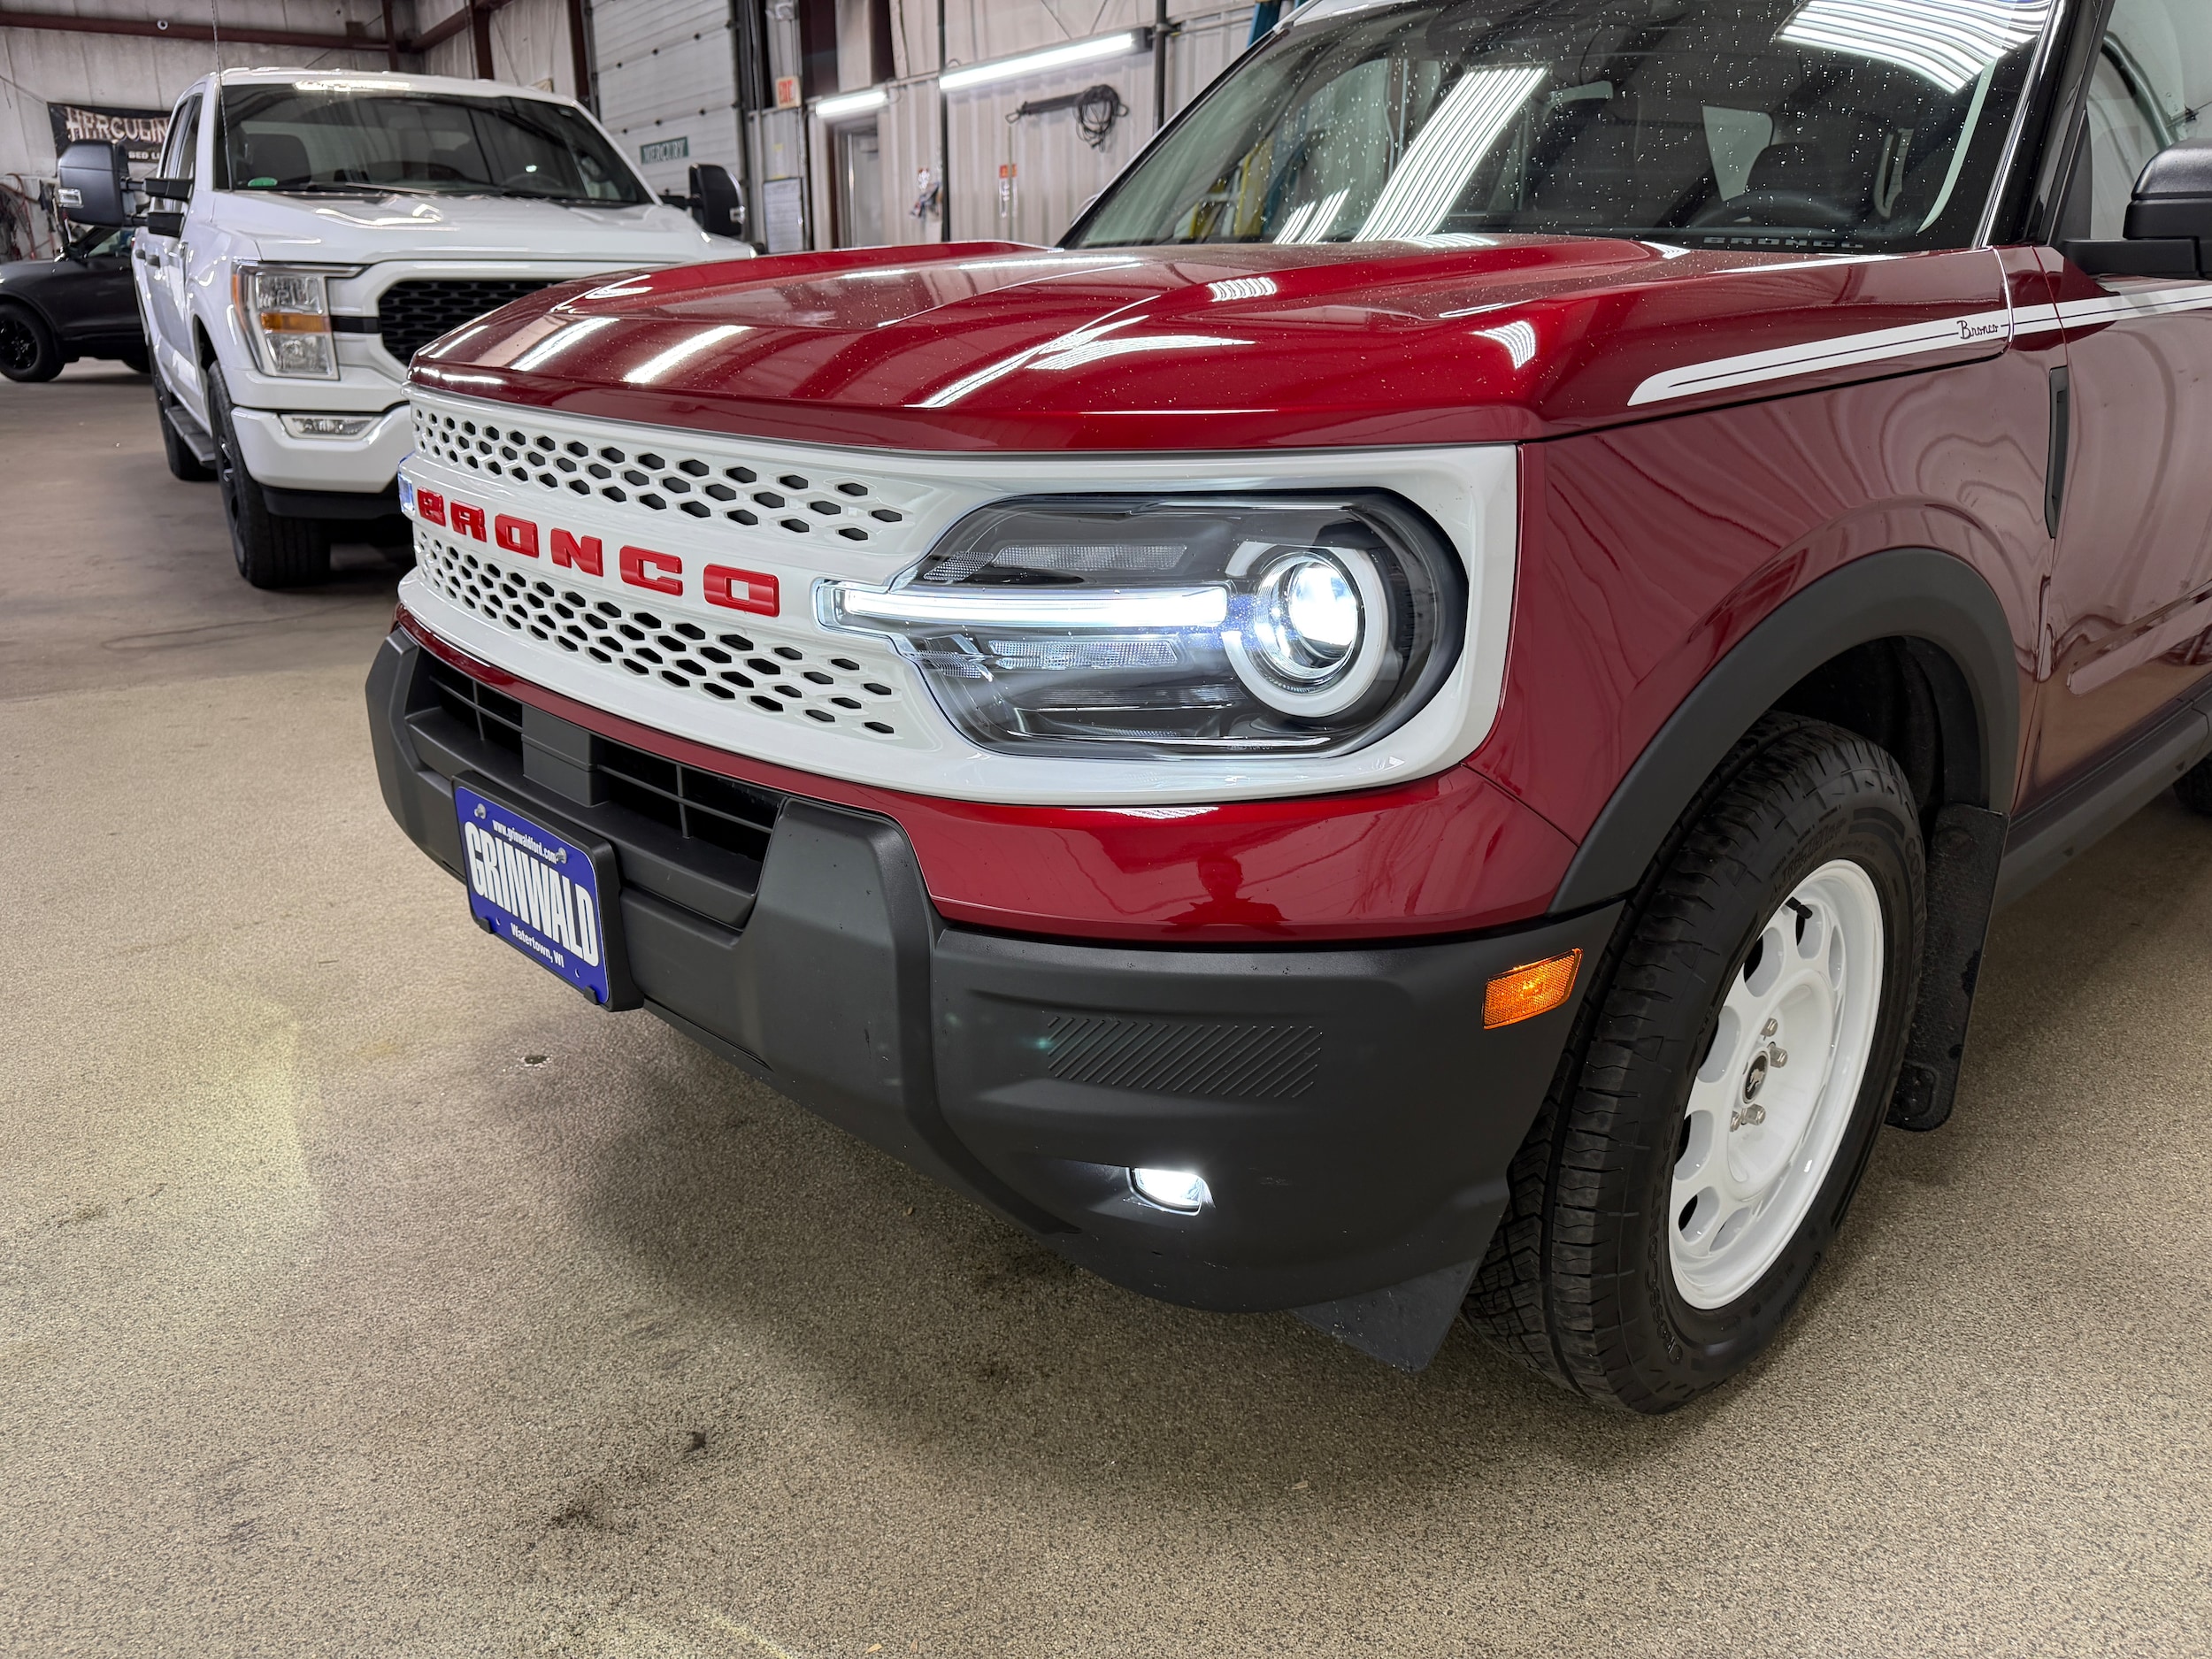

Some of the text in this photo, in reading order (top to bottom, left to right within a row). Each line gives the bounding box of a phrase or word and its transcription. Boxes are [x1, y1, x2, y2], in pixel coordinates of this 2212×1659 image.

[65, 106, 170, 144] HERCULIN
[127, 150, 150, 160] BED
[642, 139, 686, 164] MERCURY
[1702, 236, 1865, 249] BRONCO
[1956, 319, 2000, 340] Bronco
[417, 486, 780, 618] BRONCO
[492, 819, 557, 864] www.grinwaldford.com
[465, 821, 600, 967] GRINWALD
[510, 921, 565, 969] Watertown, WI
